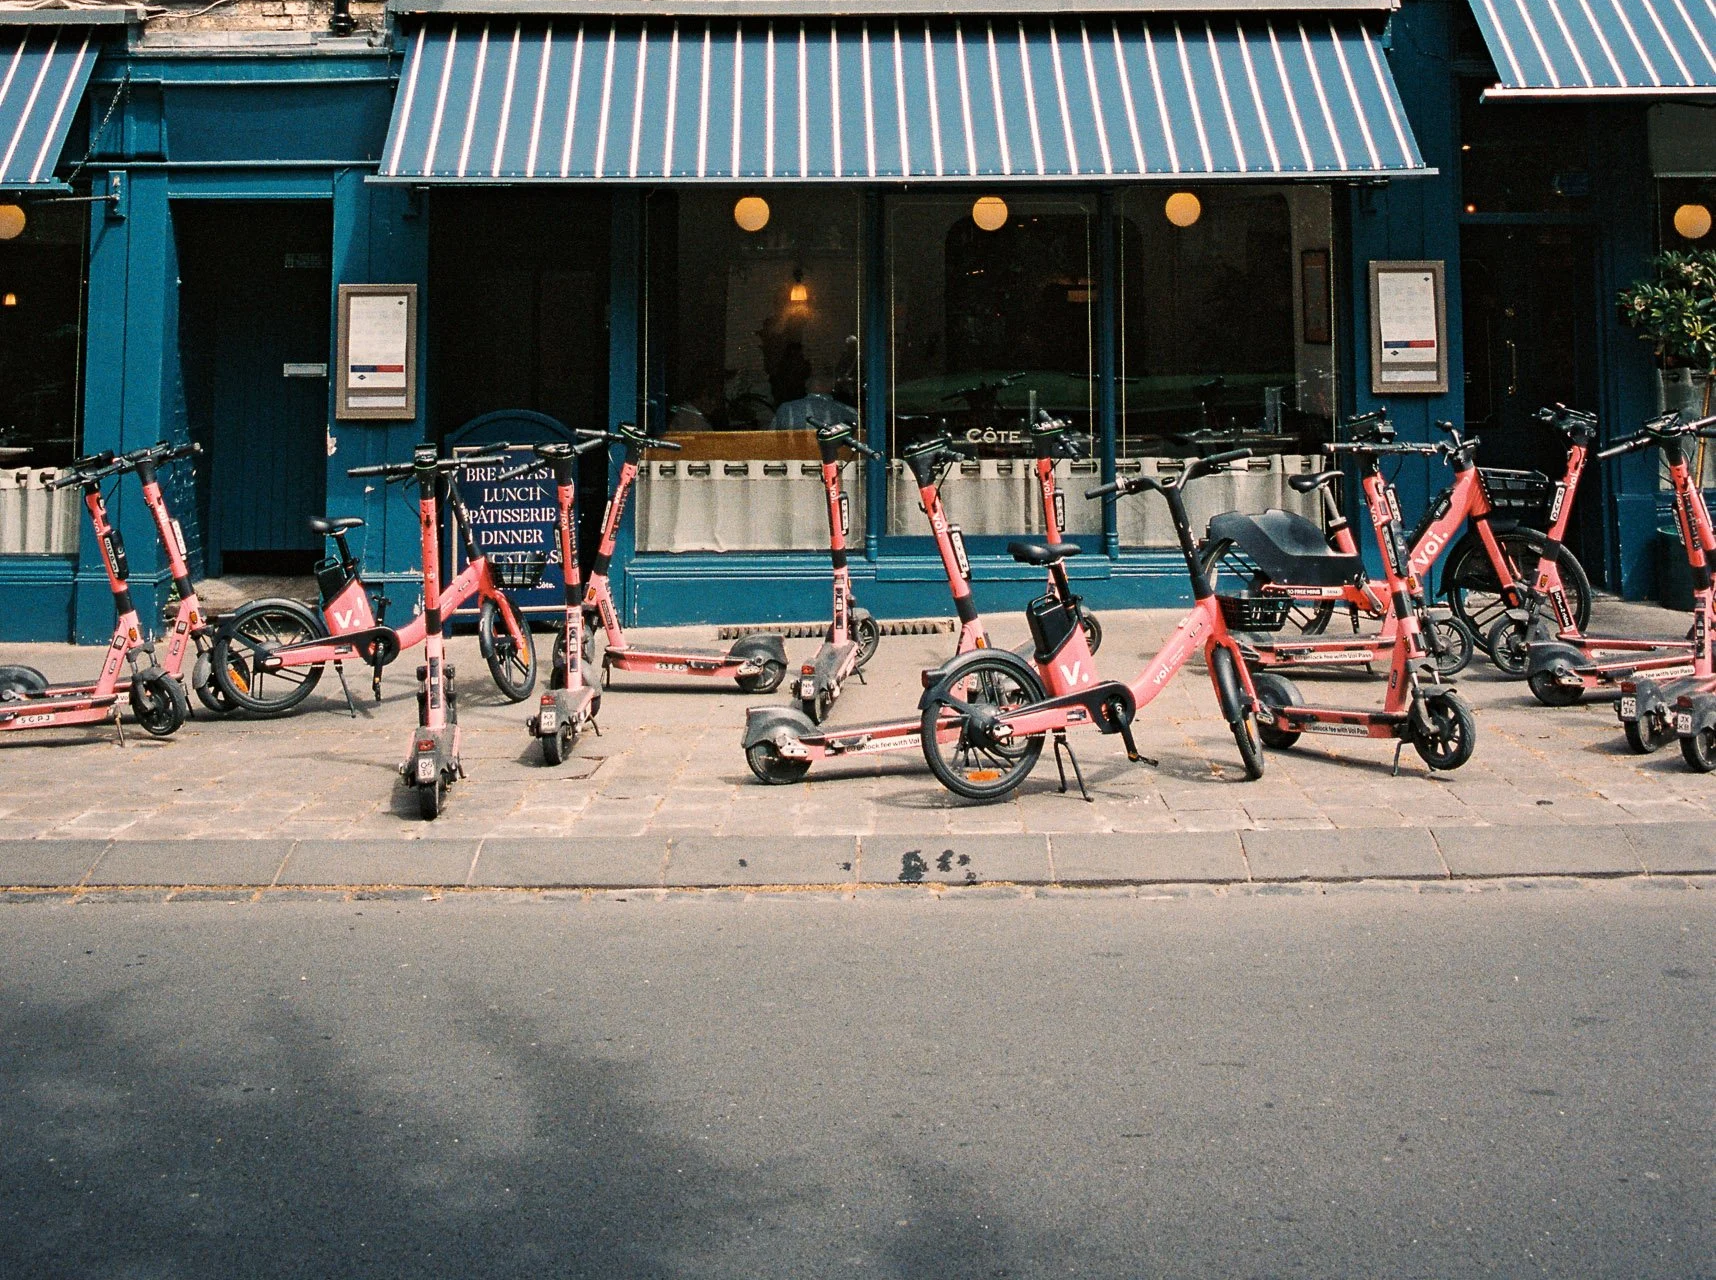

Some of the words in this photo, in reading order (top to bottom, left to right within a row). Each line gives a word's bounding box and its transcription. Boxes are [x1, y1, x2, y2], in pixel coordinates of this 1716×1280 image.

[966, 426, 1021, 444] CÔTE
[484, 486, 541, 503] LUNCH
[469, 505, 556, 524] PÂTISSERIE
[481, 529, 544, 545] DINNER
[1414, 531, 1448, 565] voi.
[893, 739, 908, 747] with
